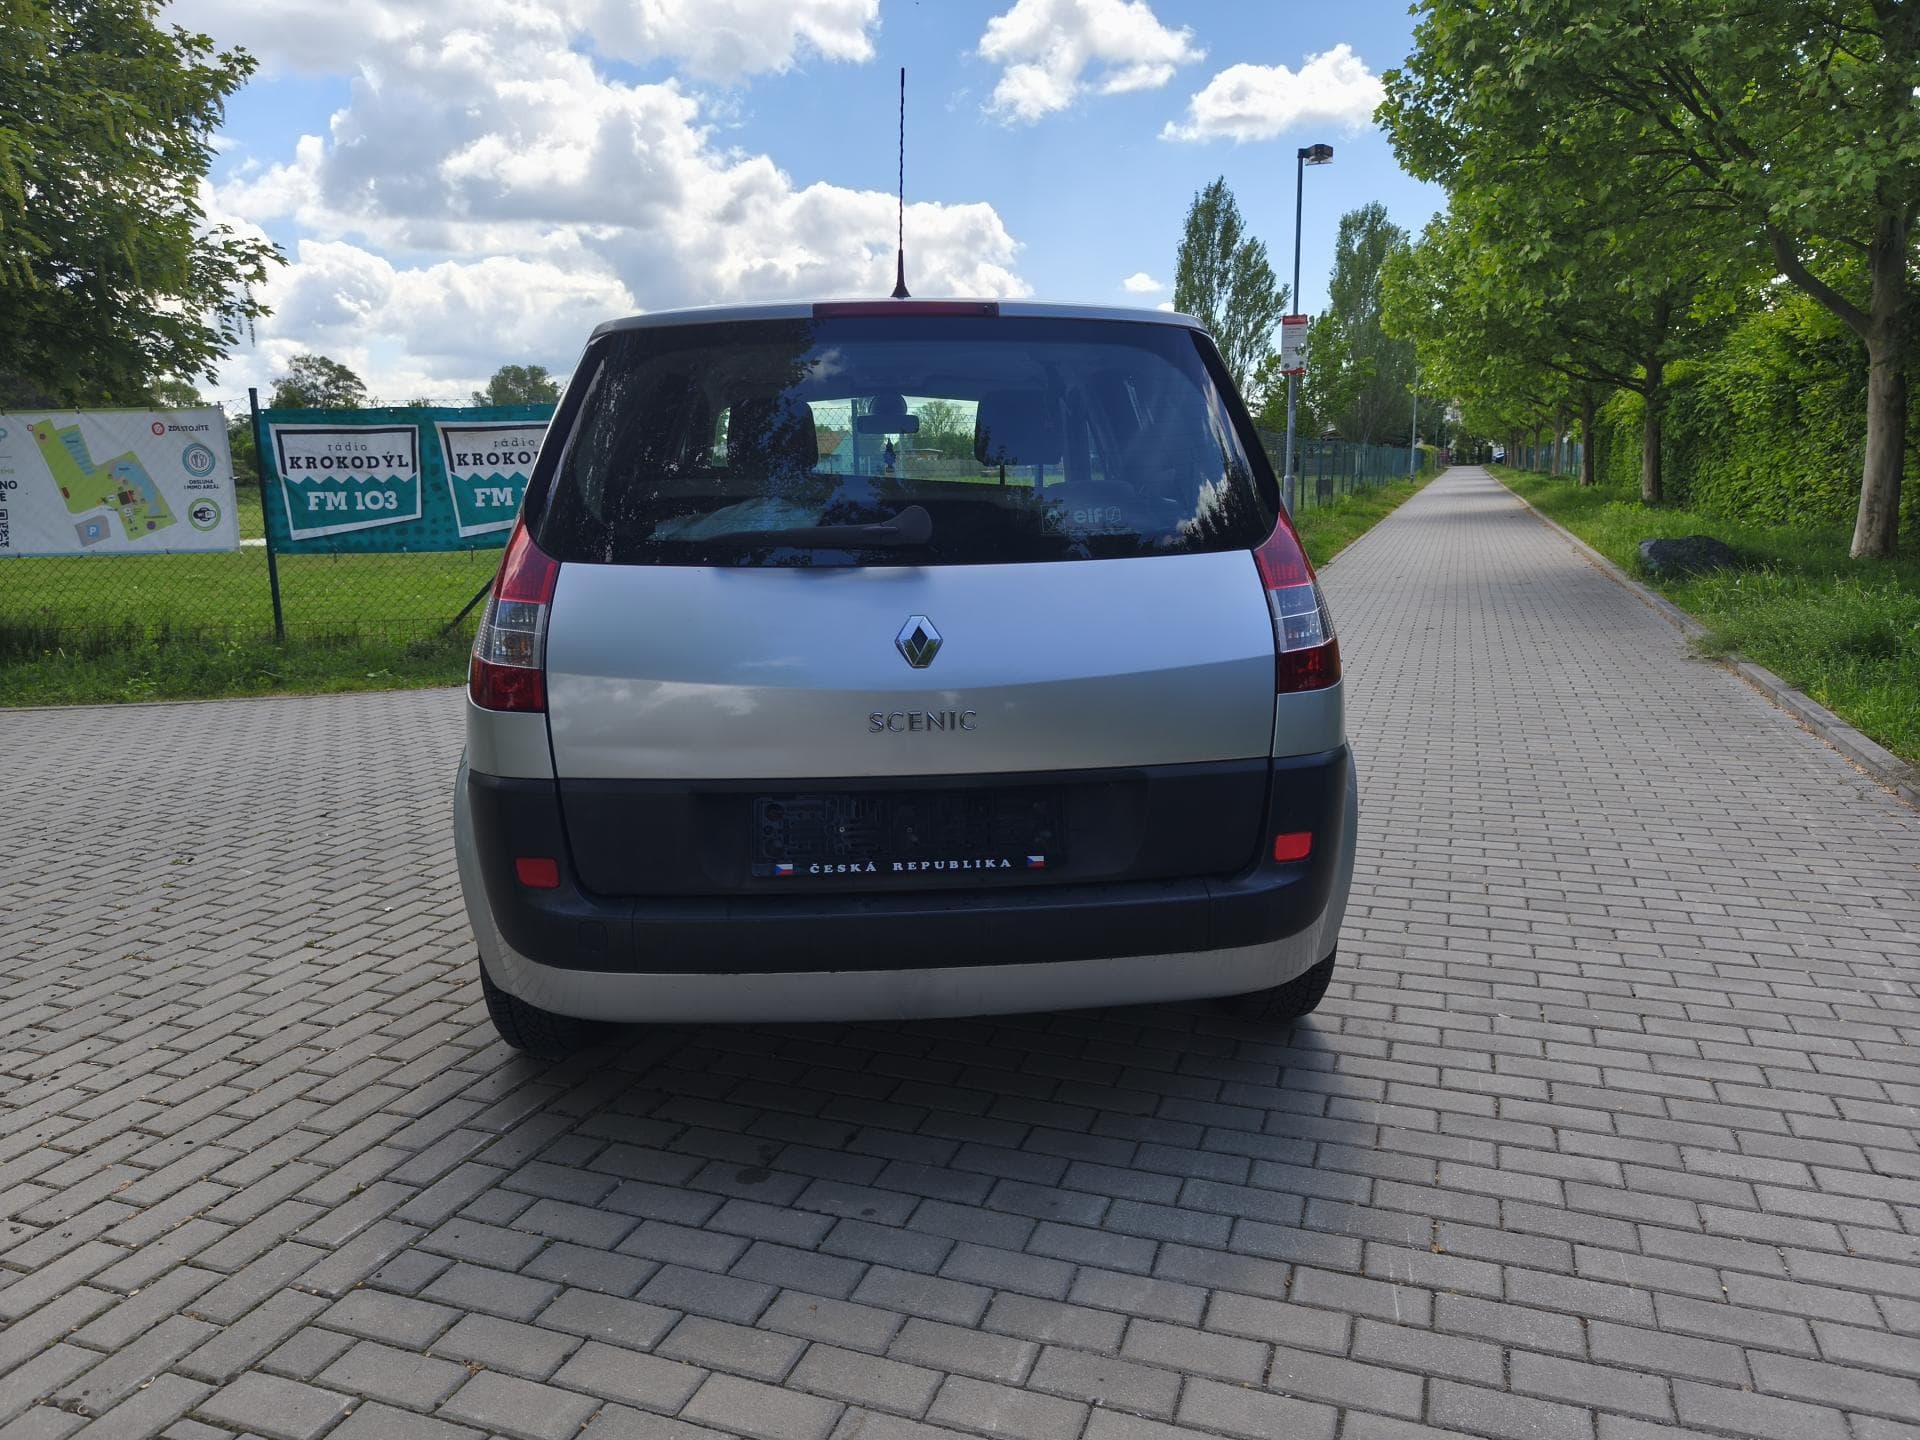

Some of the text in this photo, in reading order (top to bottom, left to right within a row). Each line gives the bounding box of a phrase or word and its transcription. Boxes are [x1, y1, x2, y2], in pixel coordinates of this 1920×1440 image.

[328, 441, 368, 451] rádio
[494, 437, 535, 448] rádio
[289, 451, 409, 470] KROKODÝL
[307, 490, 398, 511] FM 103
[474, 487, 514, 507] FM
[1073, 507, 1103, 524] elf
[89, 526, 97, 535] P
[869, 710, 977, 733] SCENIC
[809, 858, 1012, 874] ČESKÁ REPUBLIKA
